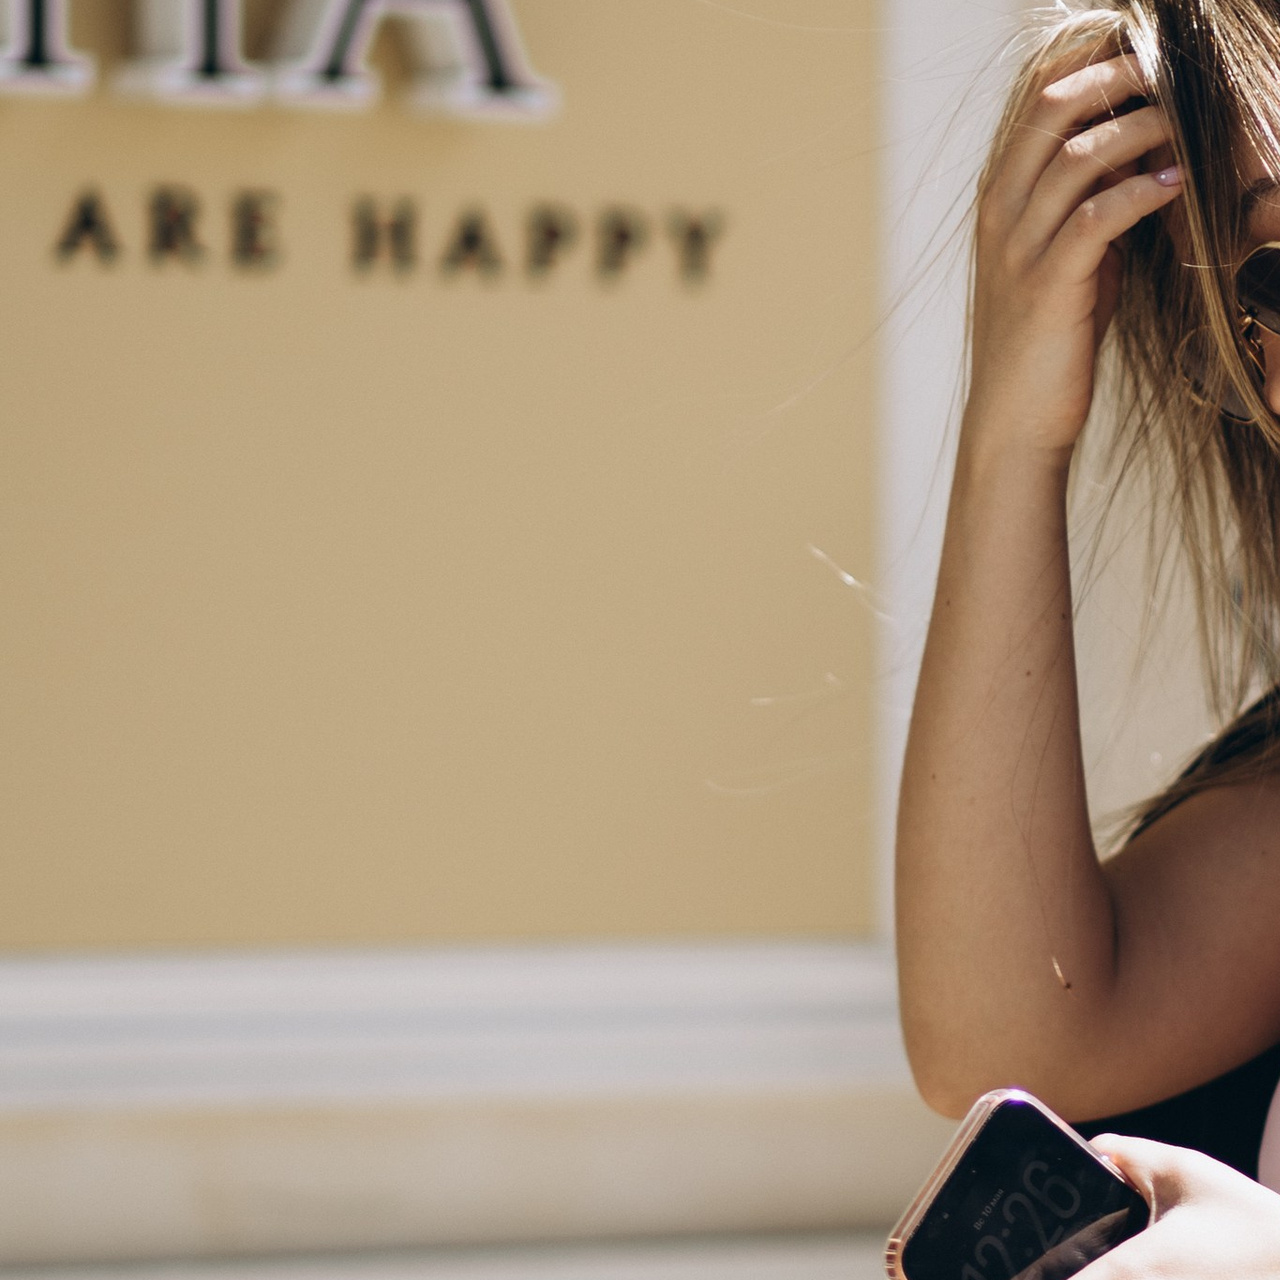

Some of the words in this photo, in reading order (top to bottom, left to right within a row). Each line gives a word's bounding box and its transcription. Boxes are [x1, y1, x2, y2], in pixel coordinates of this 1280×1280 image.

[54, 186, 286, 275] ARE
[351, 193, 726, 292] HAPPY
[982, 1205, 992, 1218] 10
